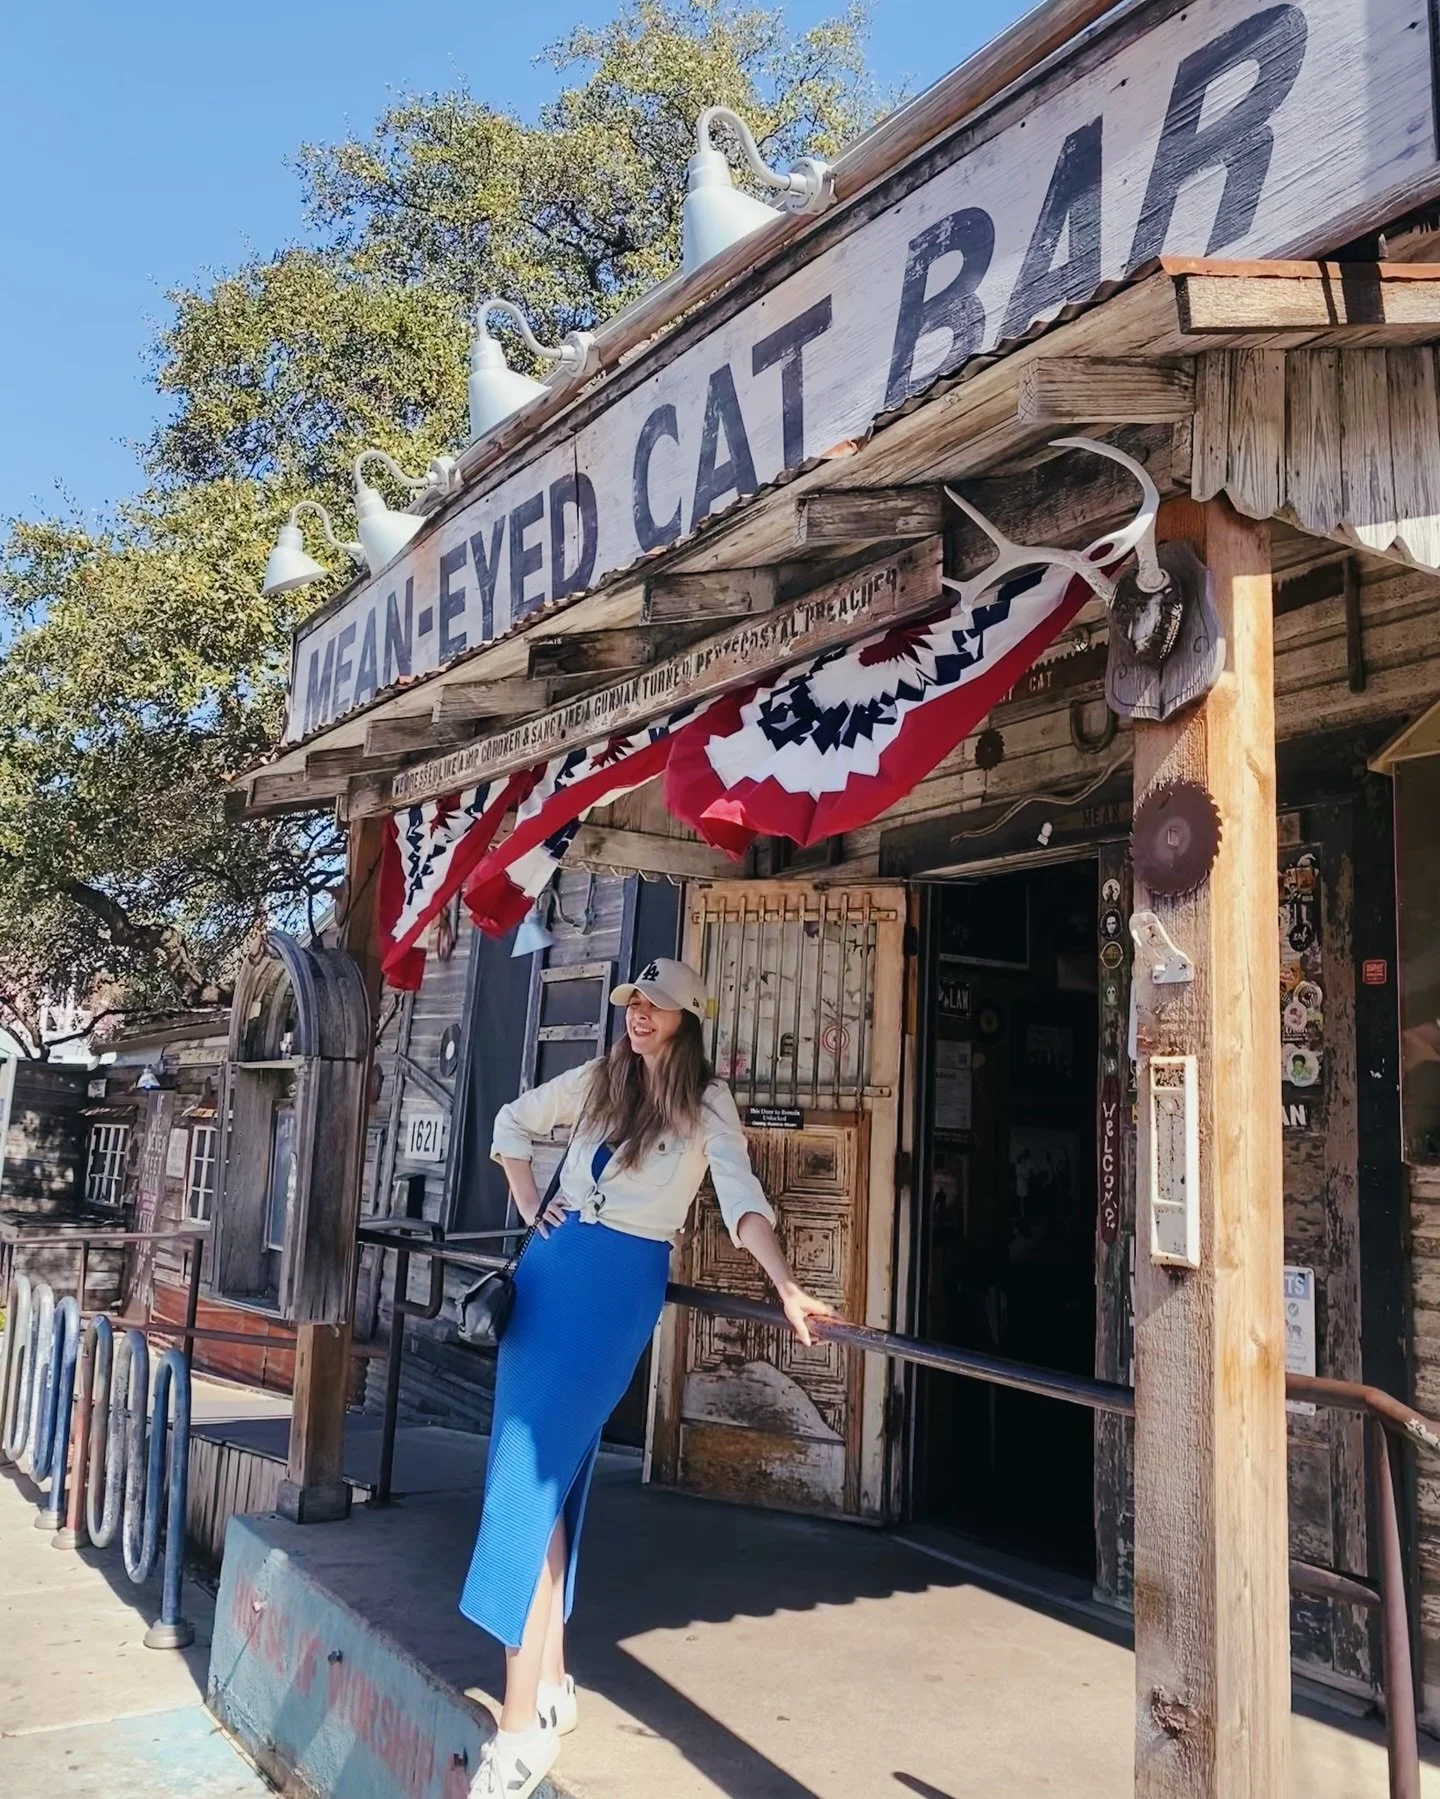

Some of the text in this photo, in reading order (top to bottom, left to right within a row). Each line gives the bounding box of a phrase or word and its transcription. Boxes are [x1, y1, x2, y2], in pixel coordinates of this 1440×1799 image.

[303, 3, 1308, 734] MEAN-EYED CAT BAR
[1029, 670, 1052, 692] CAT
[522, 726, 529, 745] &
[531, 717, 555, 743] SANG
[594, 681, 638, 715] GUNMAN
[410, 1120, 438, 1152] 1621
